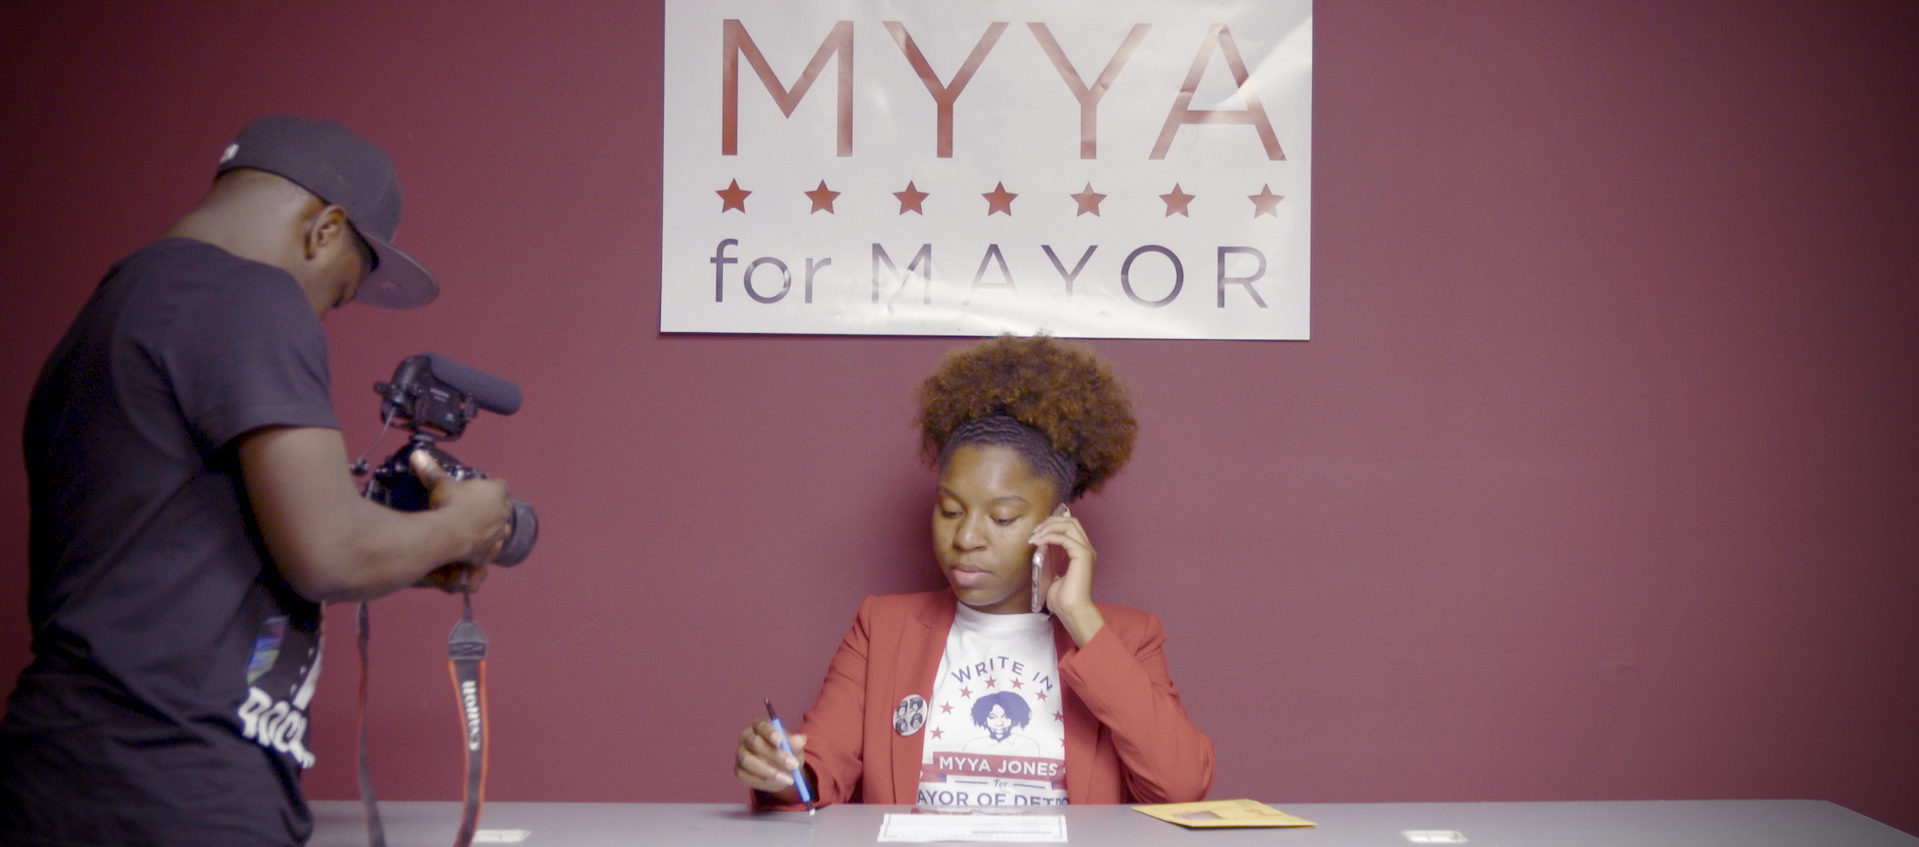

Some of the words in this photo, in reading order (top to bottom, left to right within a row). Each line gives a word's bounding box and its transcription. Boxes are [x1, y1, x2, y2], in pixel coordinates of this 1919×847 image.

[721, 18, 1287, 161] MYYA
[709, 237, 832, 305] for
[870, 241, 1269, 309] MAYOR
[950, 655, 1025, 684] WRITE
[1031, 671, 1054, 692] IN
[461, 680, 482, 751] Canon
[939, 755, 992, 773] MYYA
[997, 759, 1059, 777] JONES
[917, 789, 969, 806] AYOR
[976, 792, 1007, 806] OF
